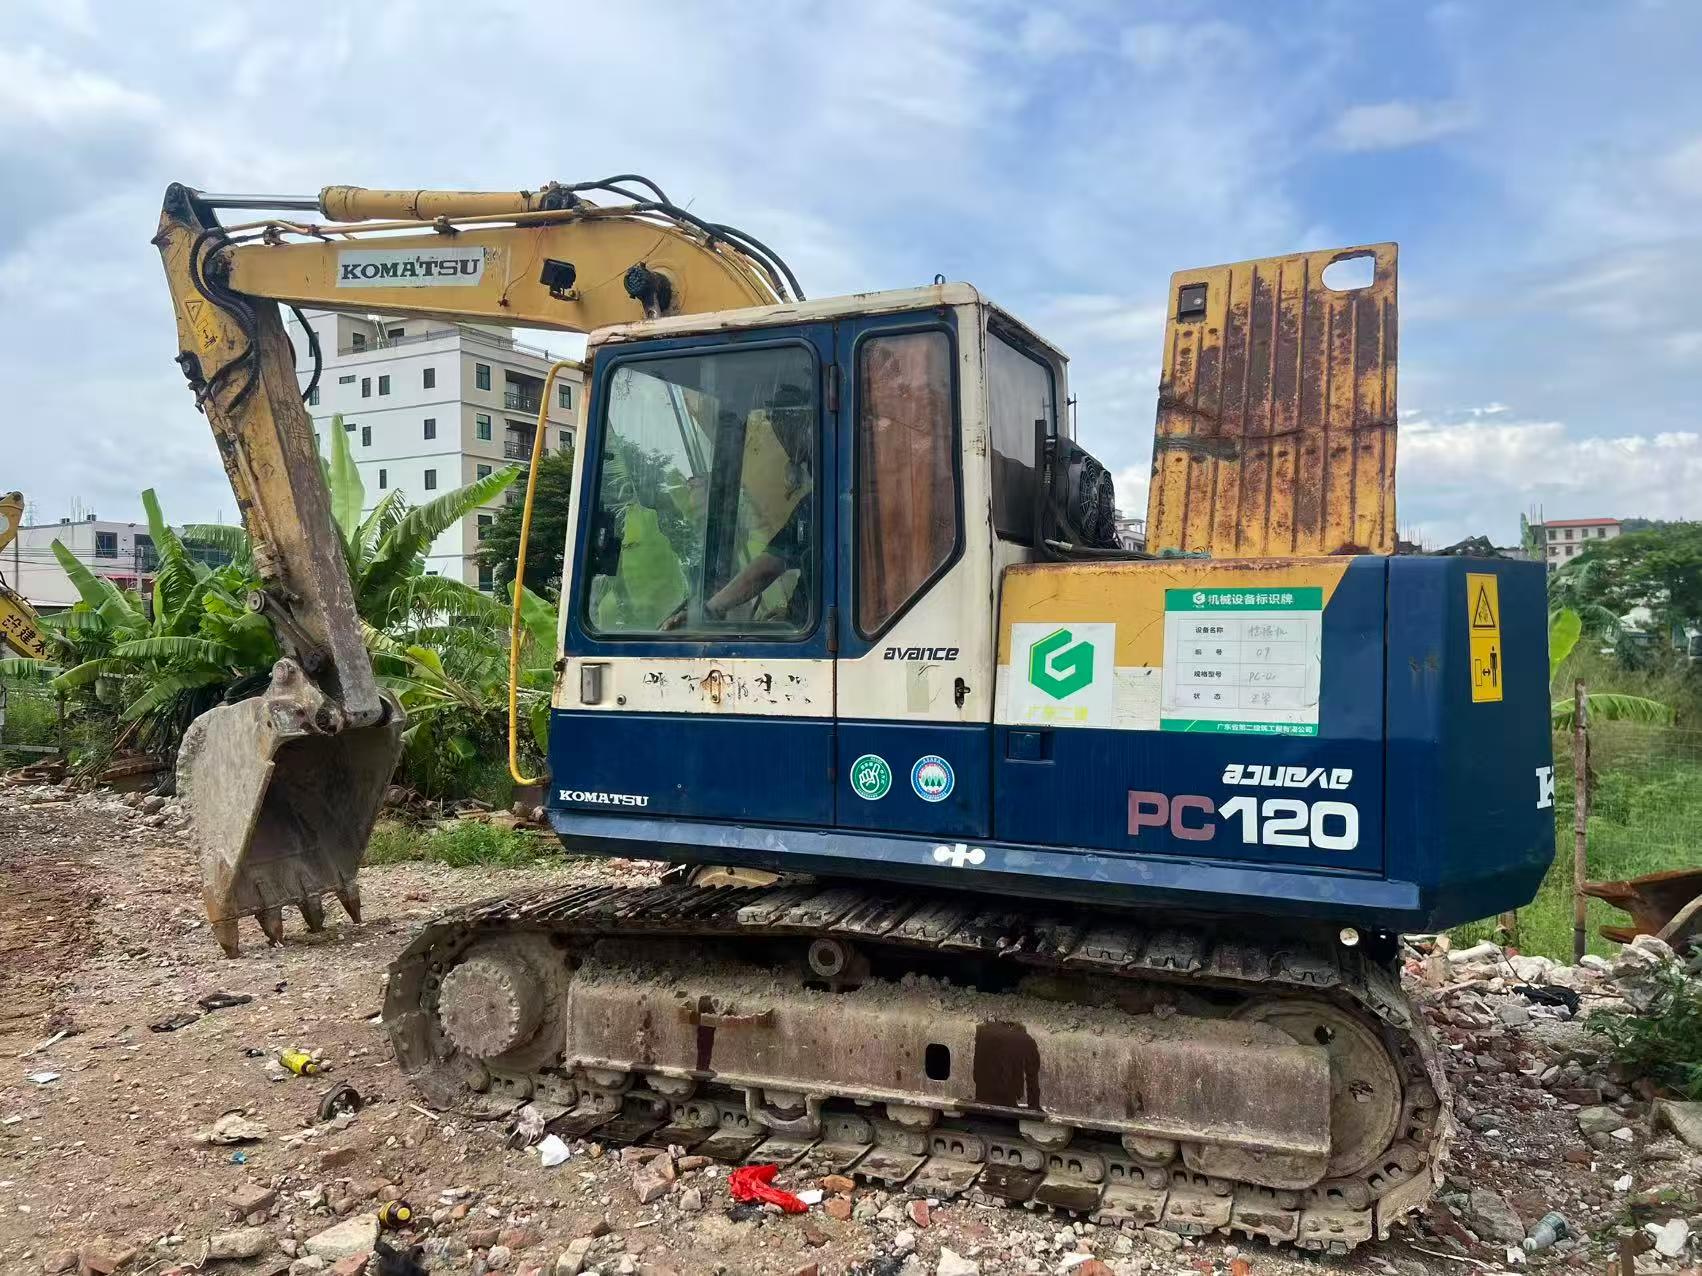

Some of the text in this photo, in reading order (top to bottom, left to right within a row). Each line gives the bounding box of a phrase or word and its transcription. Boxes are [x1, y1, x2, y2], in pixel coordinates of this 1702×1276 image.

[341, 258, 480, 280] KOMATSU
[1207, 593, 1294, 606] 机械设备标识牌
[1195, 626, 1224, 634] 设备名称
[883, 647, 960, 661] avance
[1193, 670, 1222, 678] 规格型号
[559, 789, 649, 807] KOMATSU
